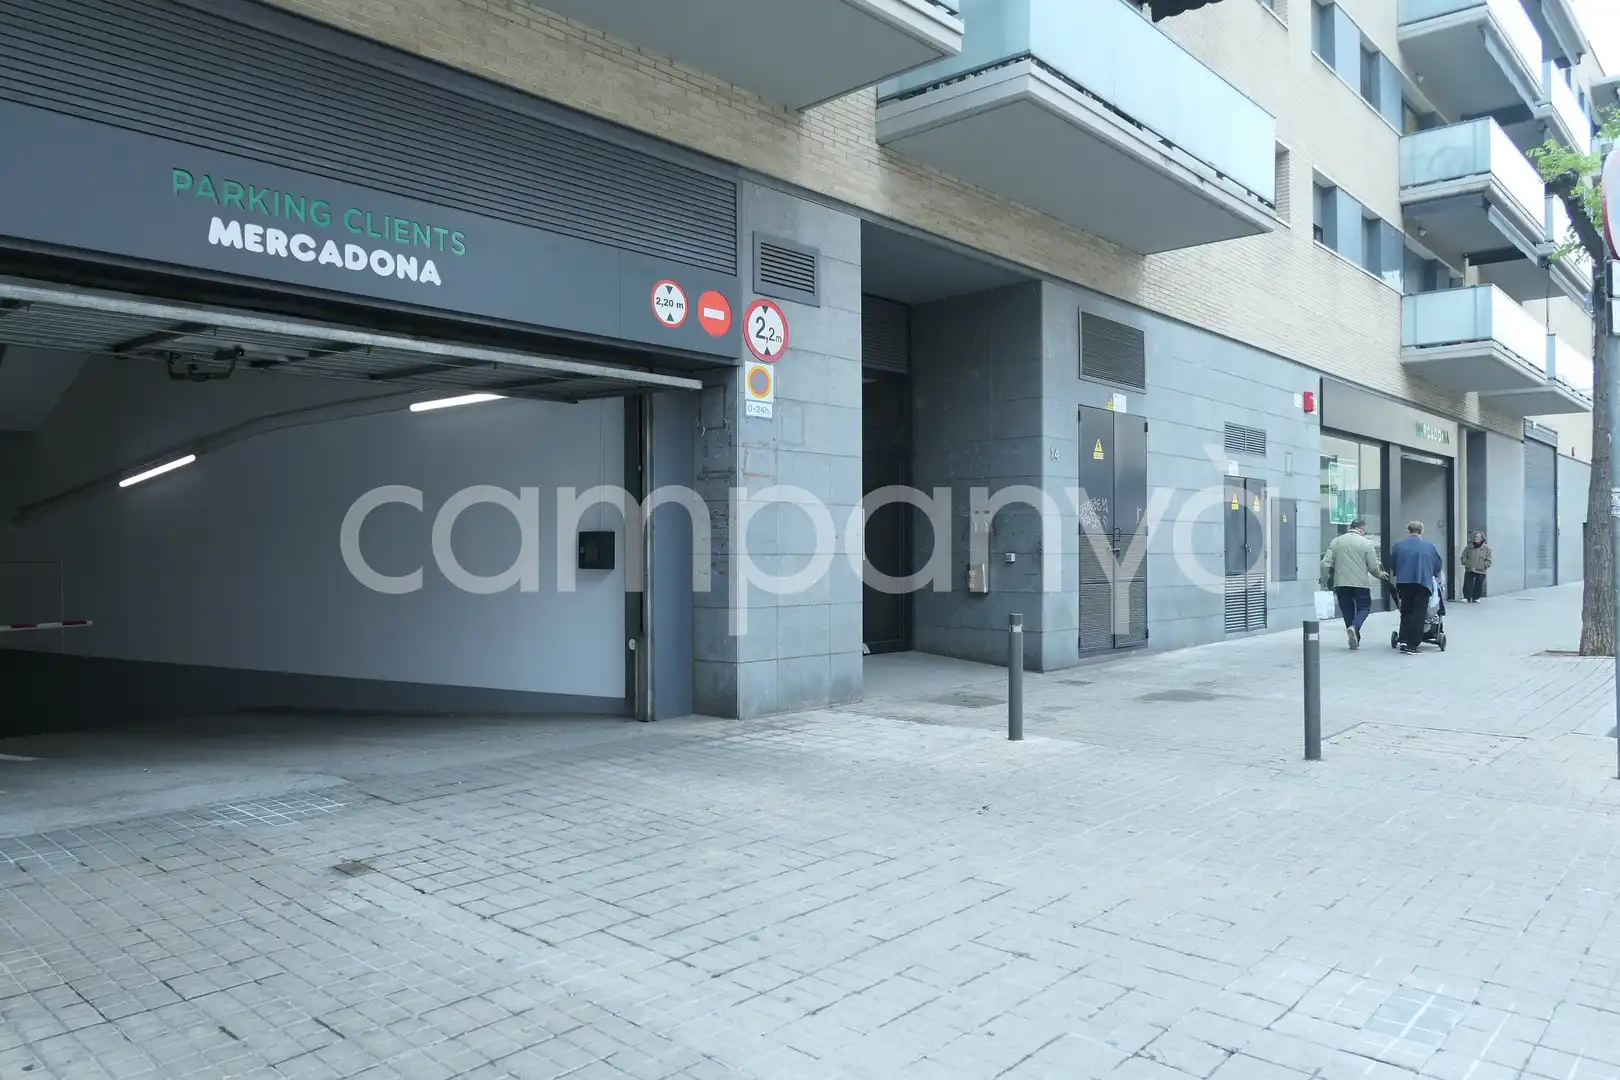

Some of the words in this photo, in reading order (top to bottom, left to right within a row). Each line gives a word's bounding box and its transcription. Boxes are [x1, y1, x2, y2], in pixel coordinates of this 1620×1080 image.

[172, 167, 332, 227] PARKING
[343, 206, 468, 257] CLIENTS
[208, 216, 442, 286] MERCADONA
[655, 296, 674, 308] 2,20
[1050, 447, 1059, 460] 14
